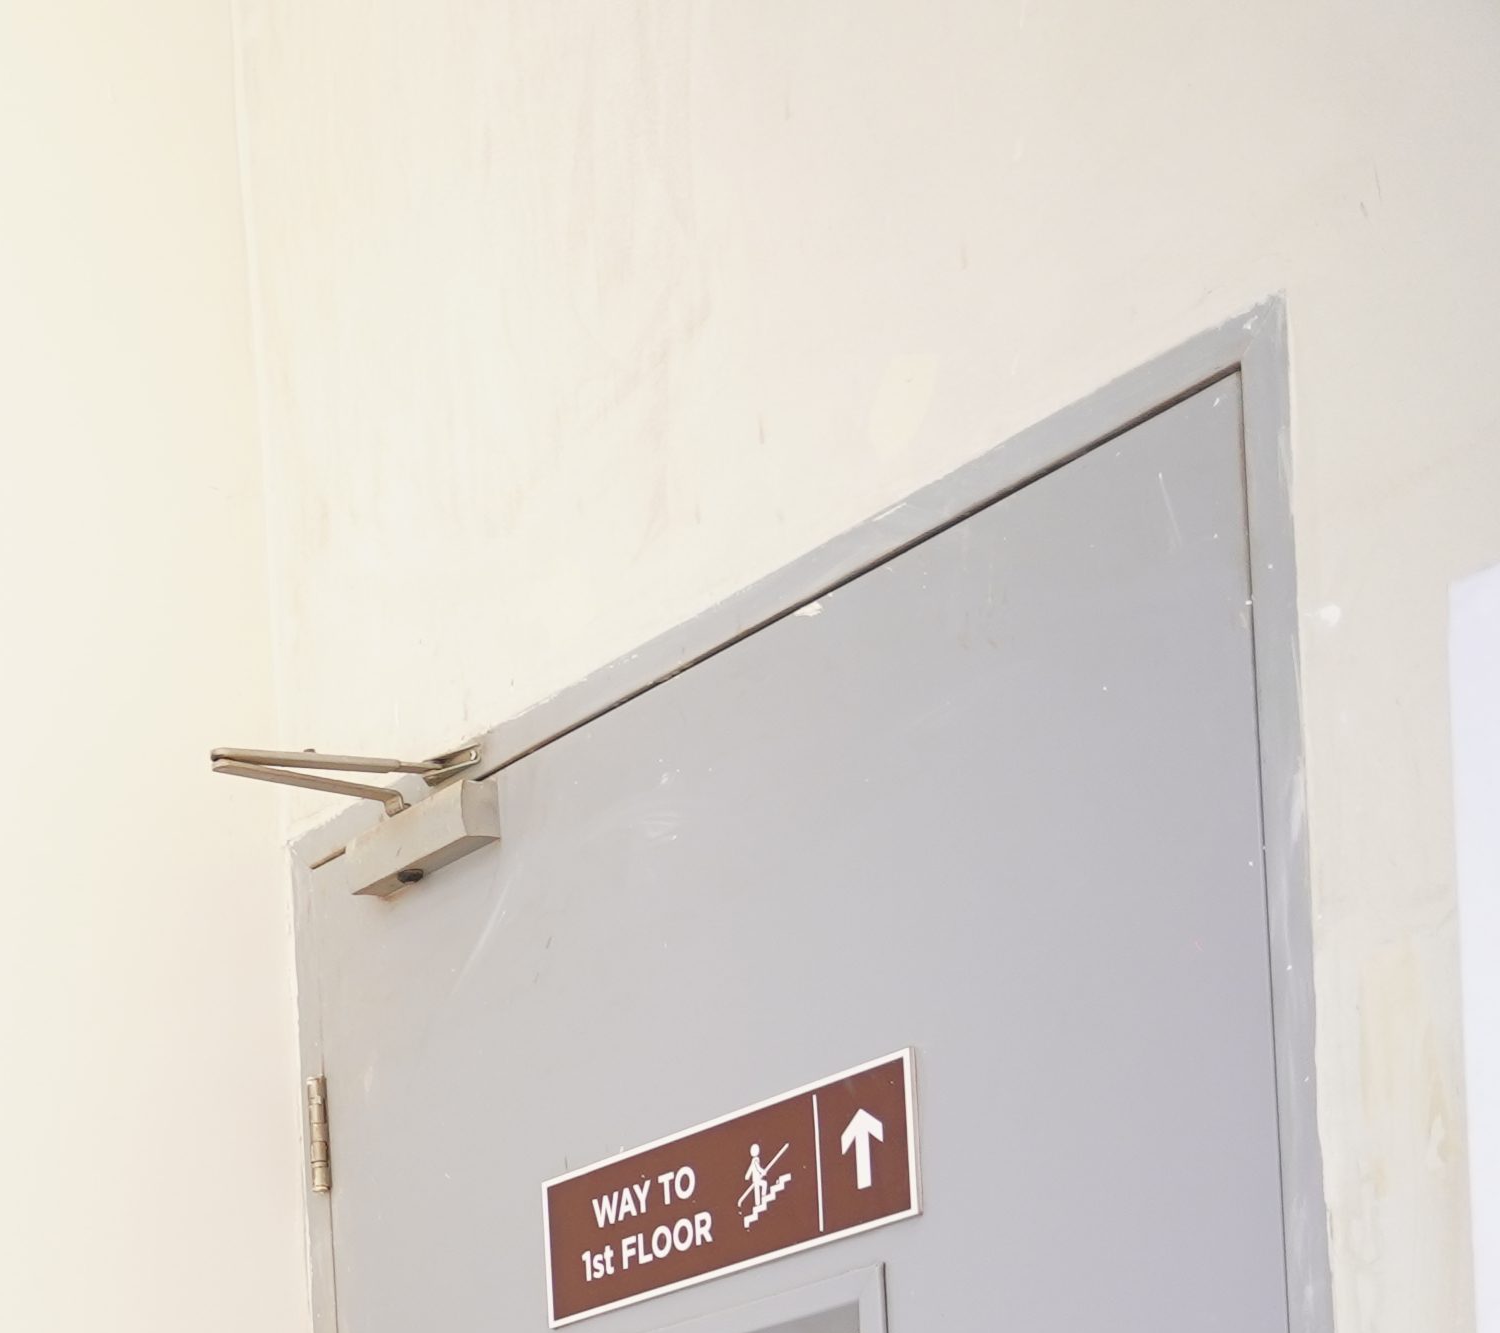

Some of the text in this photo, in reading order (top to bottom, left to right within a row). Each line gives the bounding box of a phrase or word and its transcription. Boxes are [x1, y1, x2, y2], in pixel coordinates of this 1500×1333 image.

[592, 1166, 696, 1228] WAY TO
[581, 1211, 713, 1282] 1st FLOOR
